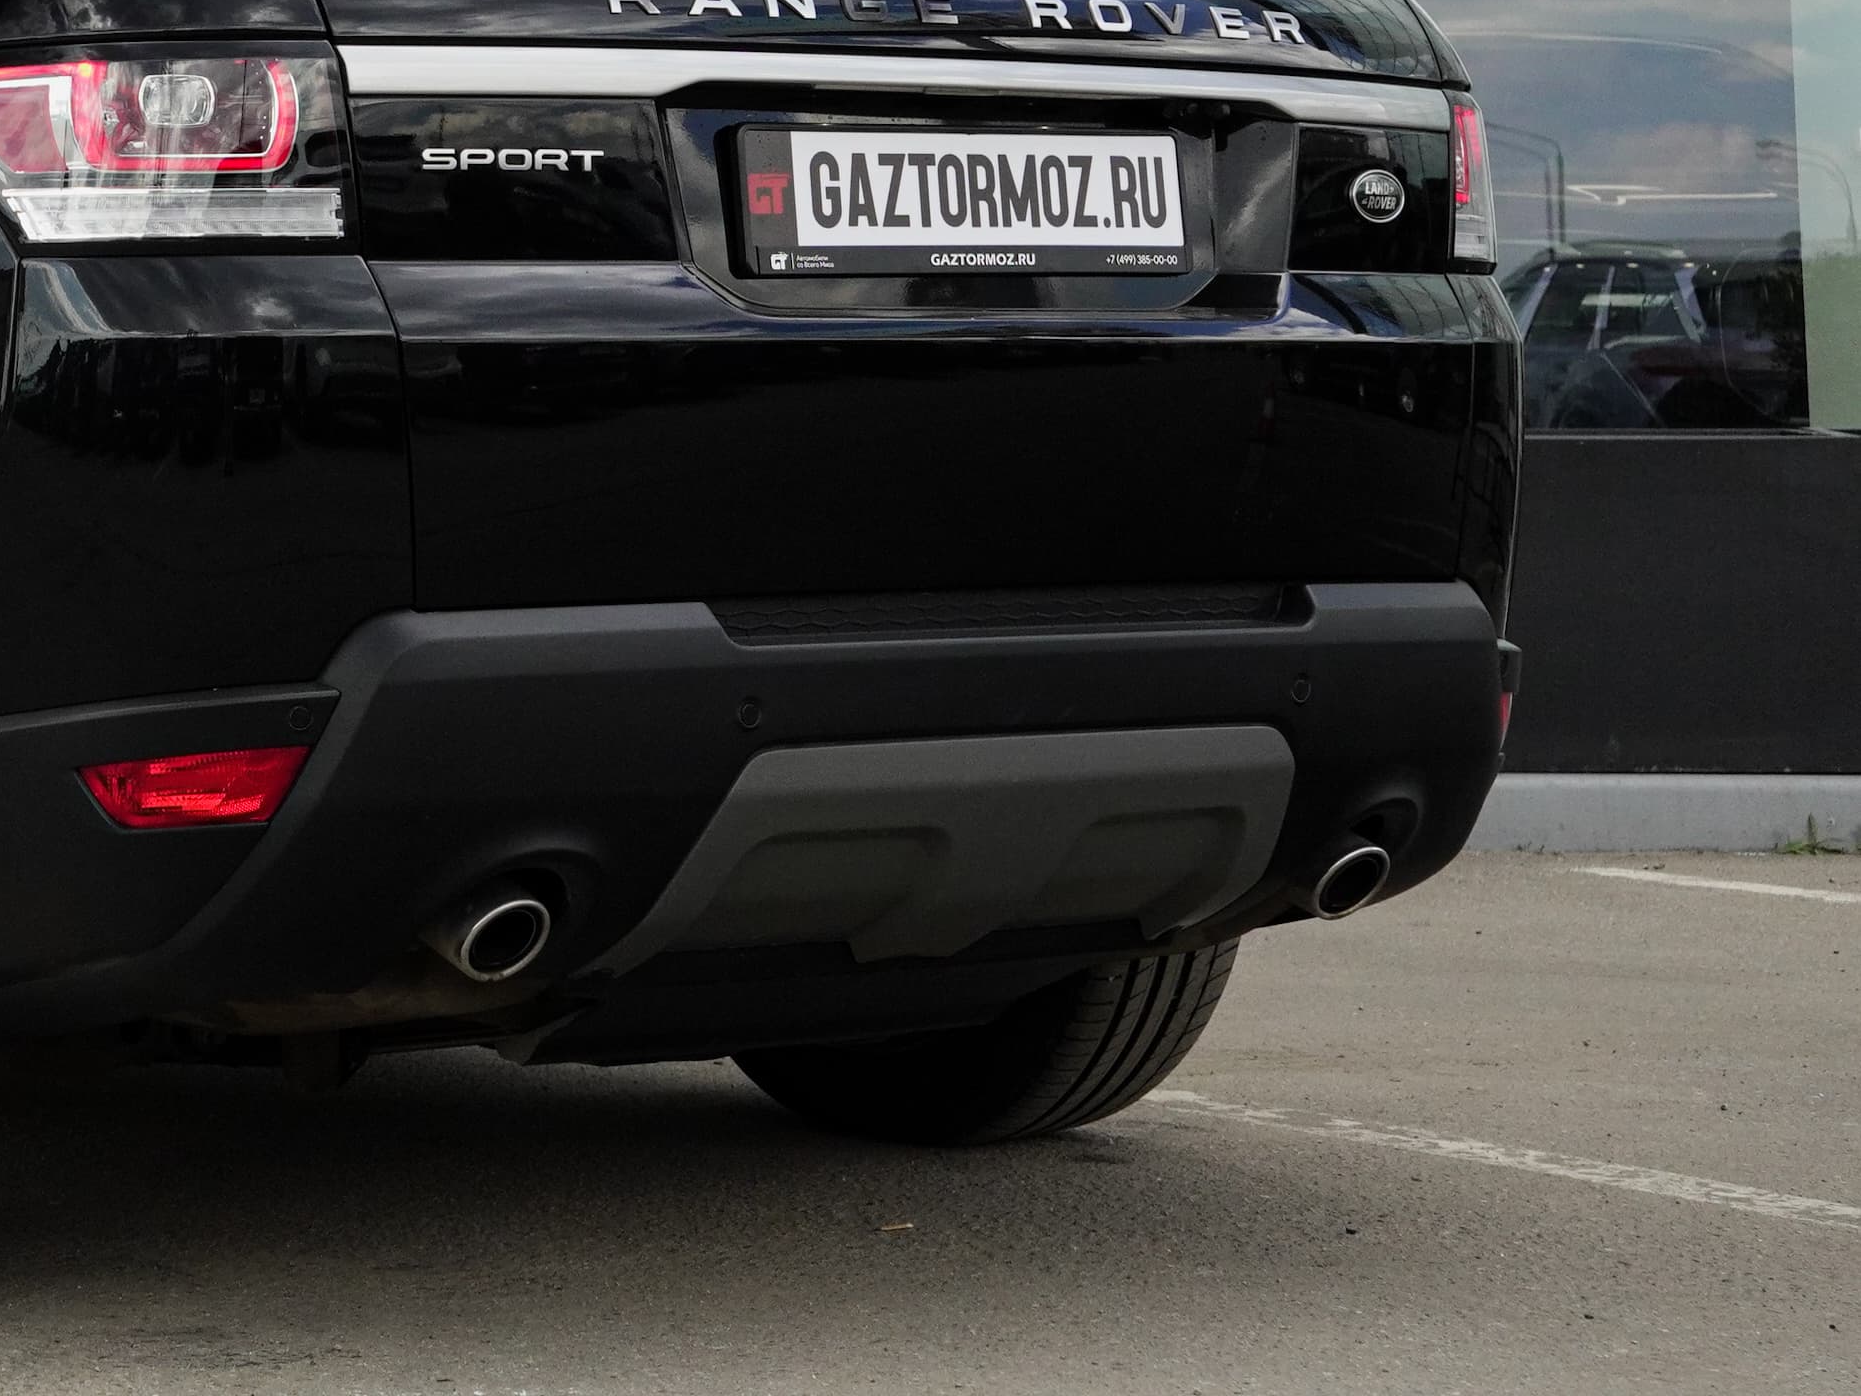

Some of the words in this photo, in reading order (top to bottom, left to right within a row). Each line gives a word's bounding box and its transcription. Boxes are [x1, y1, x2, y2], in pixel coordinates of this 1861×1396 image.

[421, 147, 605, 172] SPORT
[808, 150, 1168, 229] GAZTORMOZ.RU
[1364, 181, 1390, 195] LAND
[1367, 195, 1397, 210] ROVER
[930, 253, 1036, 266] GAZTORMOZ.RU
